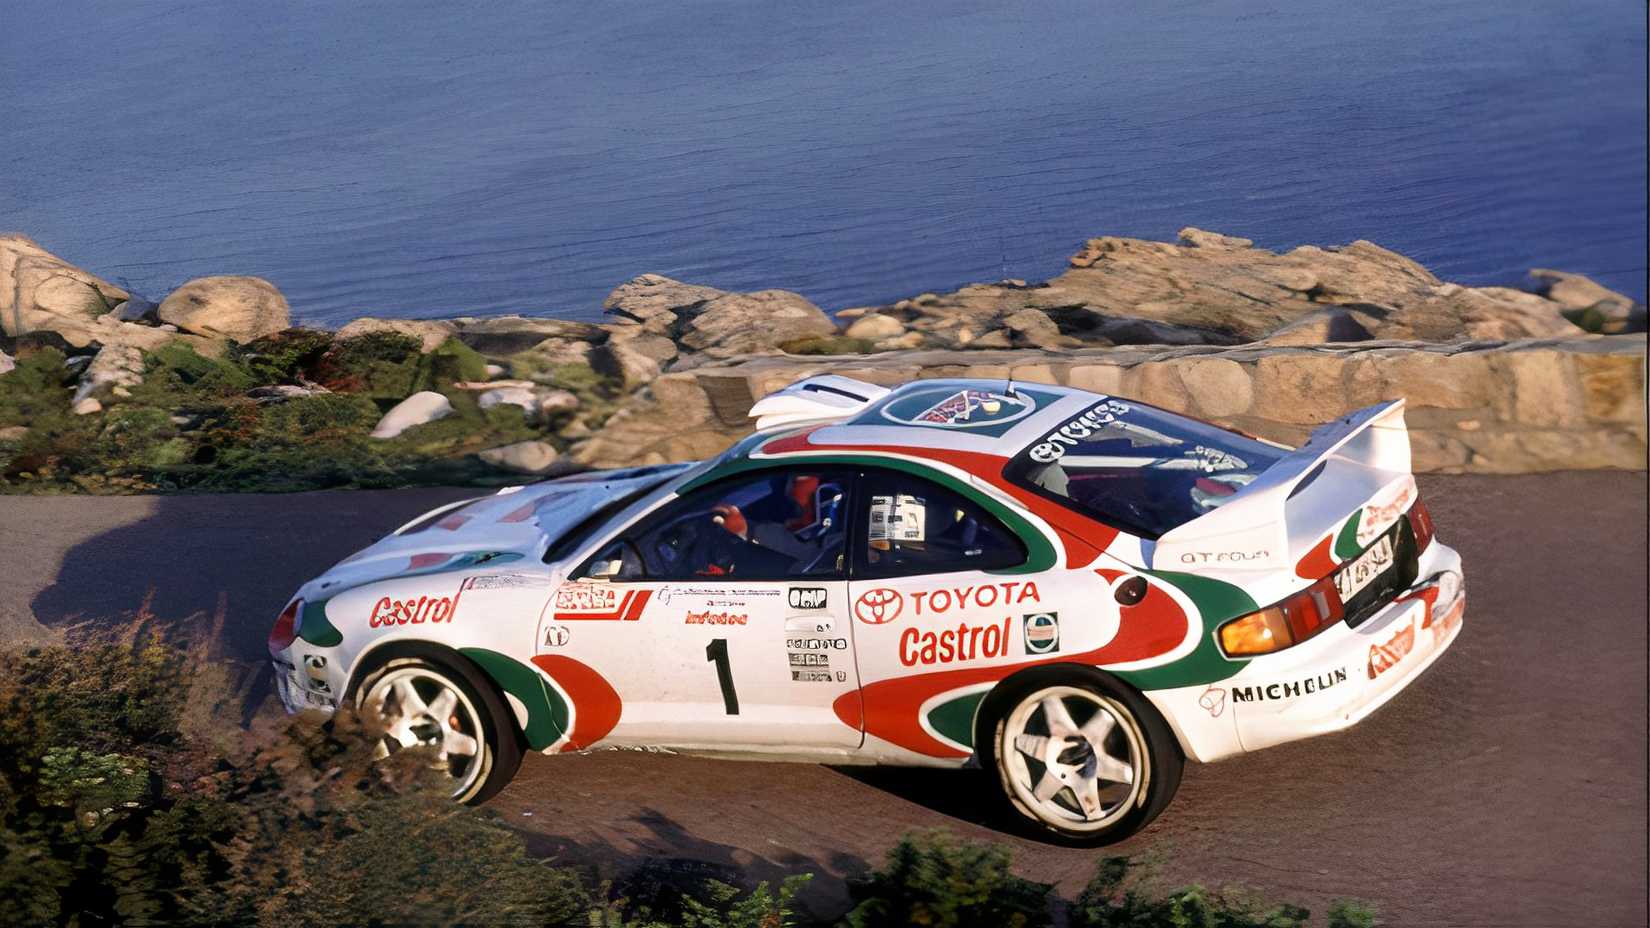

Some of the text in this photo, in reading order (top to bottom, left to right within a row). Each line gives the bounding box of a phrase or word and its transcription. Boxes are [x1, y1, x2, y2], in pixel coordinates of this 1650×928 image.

[369, 591, 461, 628] Castrol
[910, 581, 1041, 615] TOYOTA
[899, 616, 1012, 666] Castrol
[706, 638, 740, 715] 1
